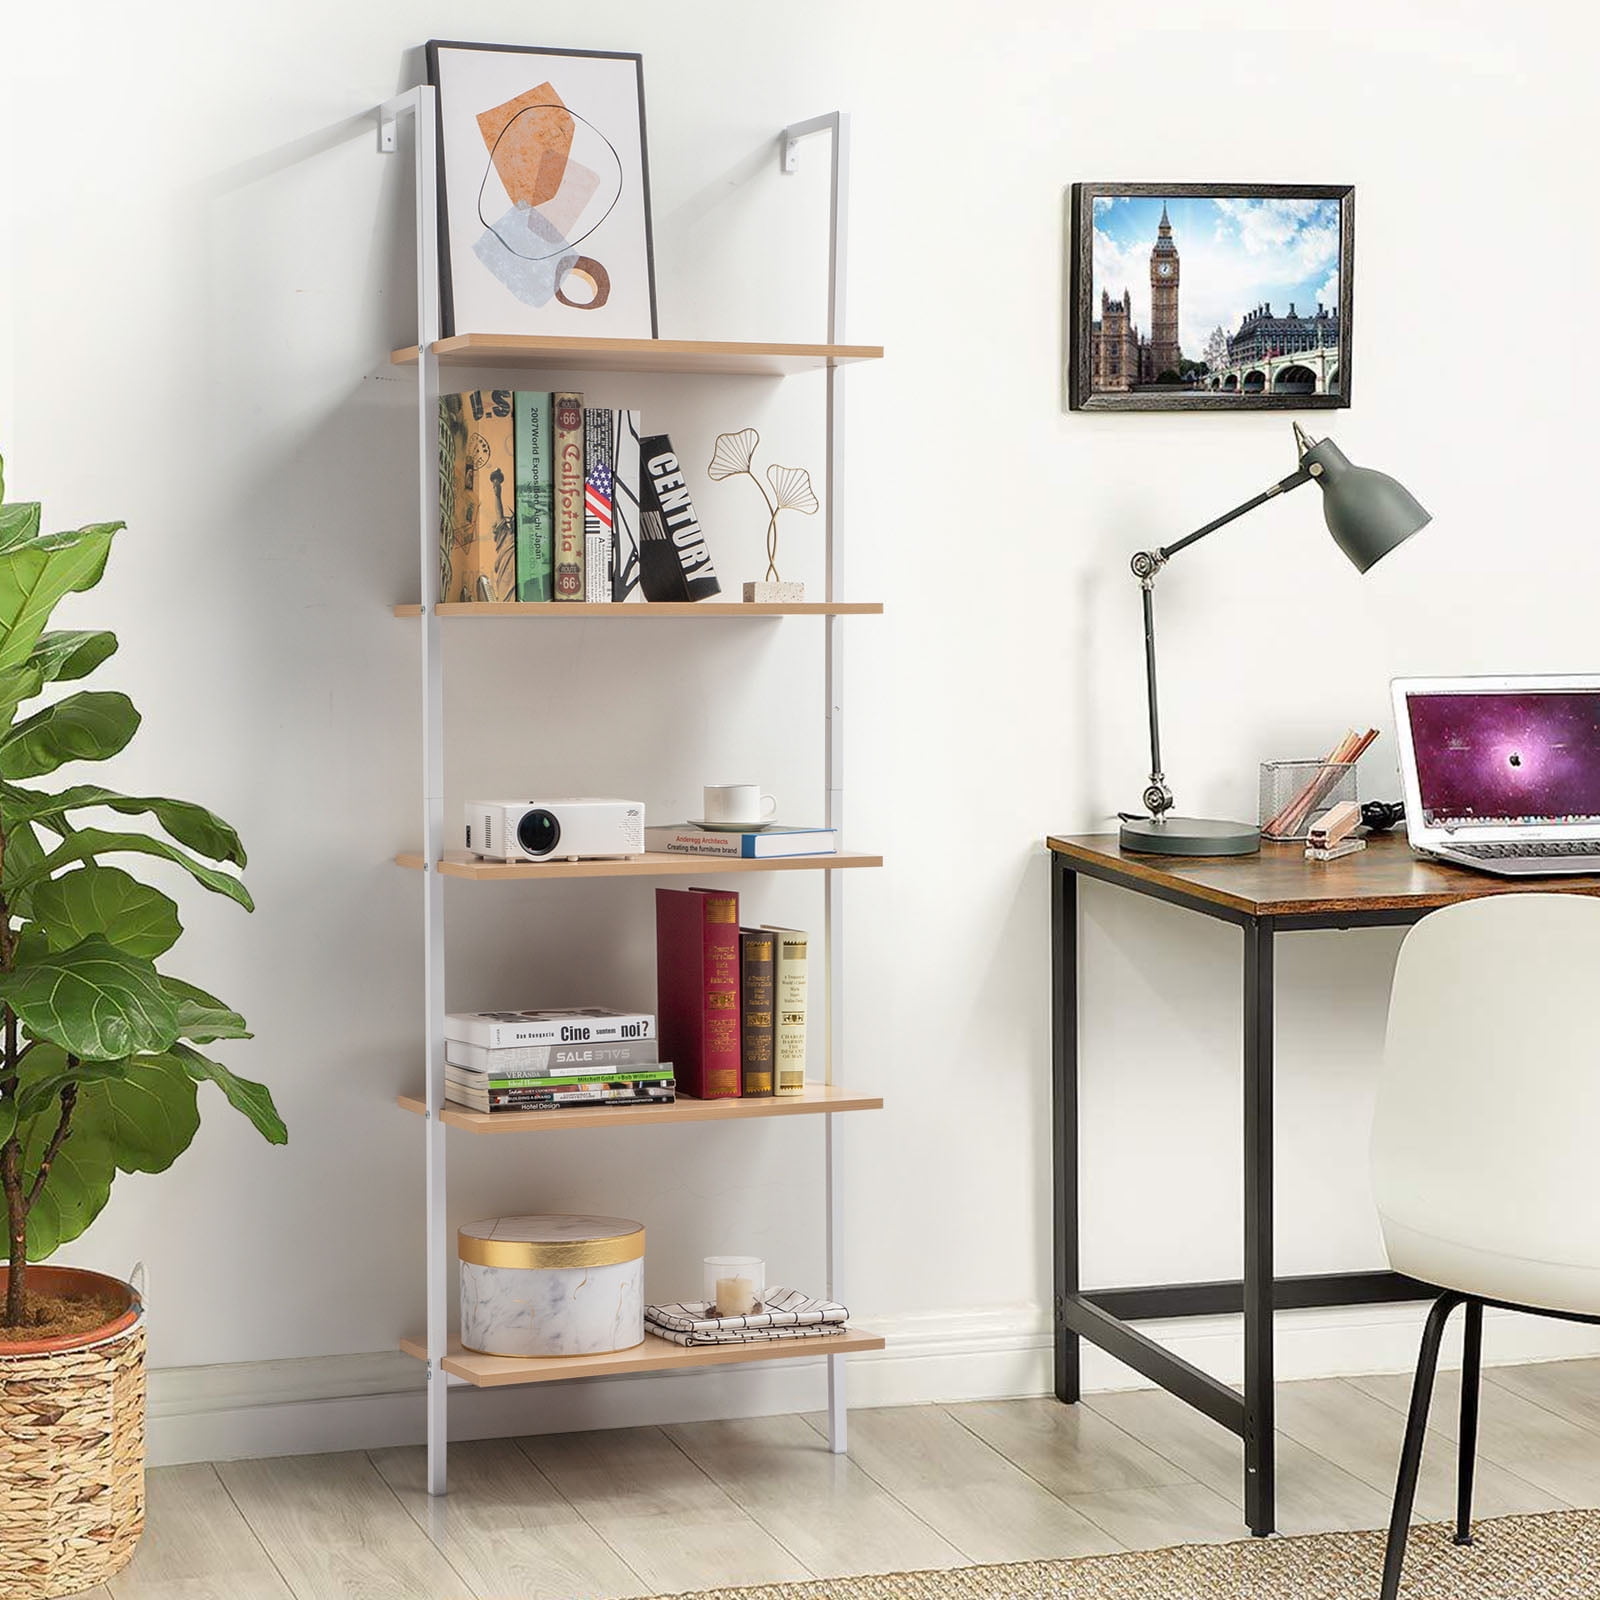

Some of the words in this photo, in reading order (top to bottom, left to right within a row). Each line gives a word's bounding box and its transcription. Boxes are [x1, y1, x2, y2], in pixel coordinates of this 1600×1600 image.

[563, 412, 576, 425] 66
[559, 443, 581, 553] California
[647, 452, 717, 582] CENTURY
[533, 533, 543, 560] Japan
[563, 577, 576, 589] 66
[676, 836, 700, 845] Anderegg
[702, 837, 729, 845] Architects
[667, 843, 688, 852] Creating
[561, 1026, 591, 1042] Cine
[621, 1020, 649, 1038] noi?
[556, 1050, 593, 1063] SALE
[506, 1071, 541, 1079] VERANDA
[539, 1102, 560, 1110] Design
